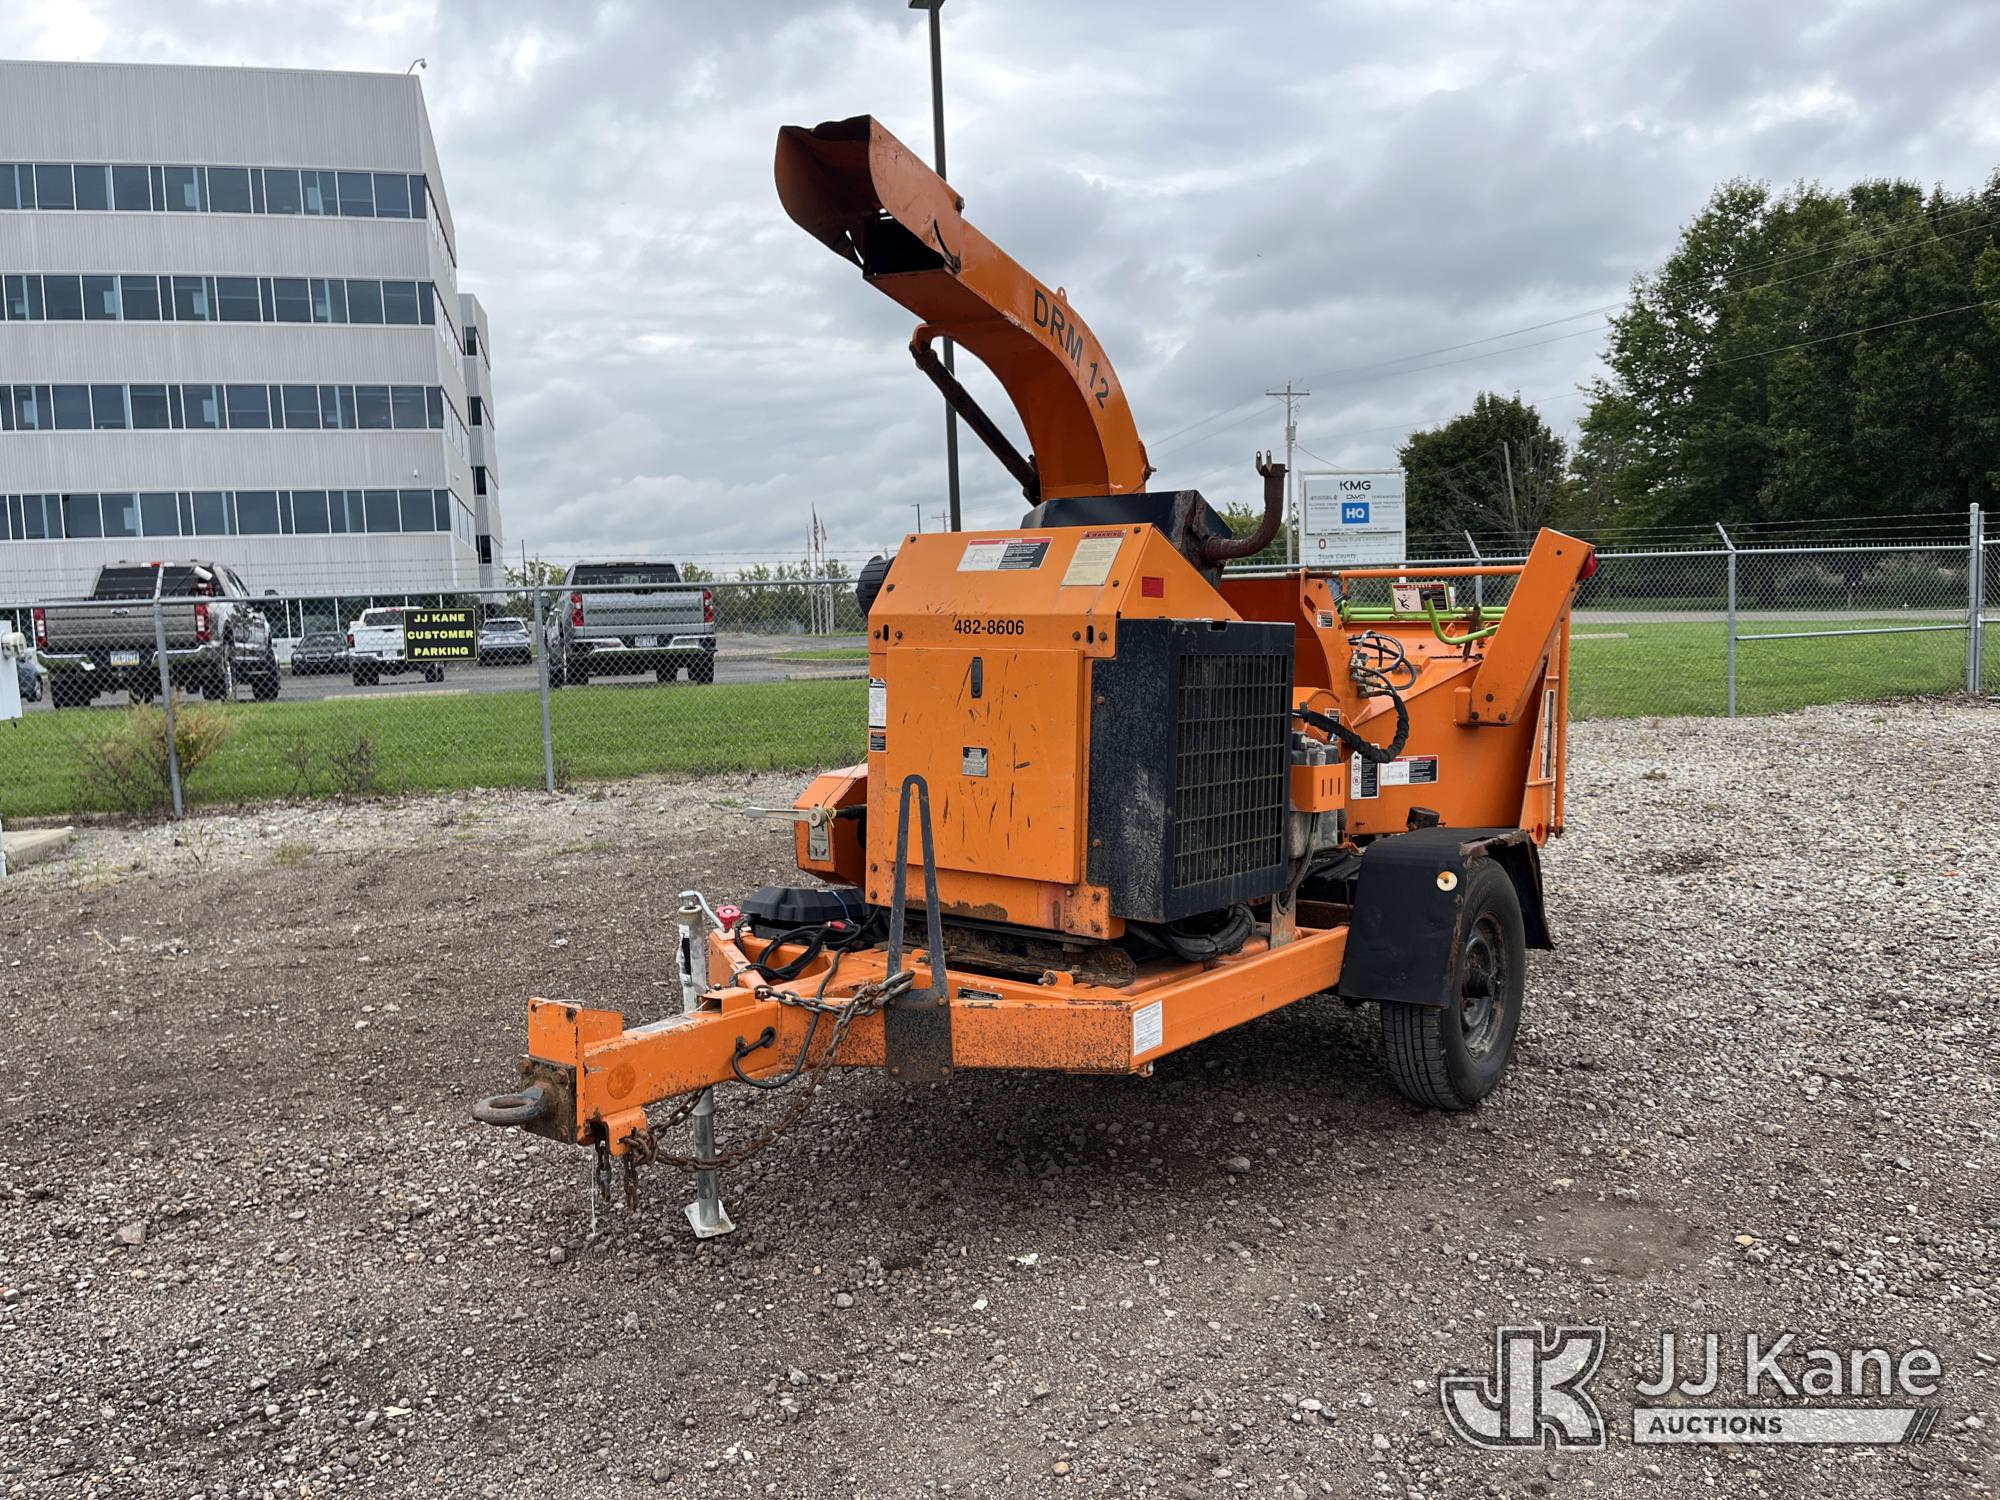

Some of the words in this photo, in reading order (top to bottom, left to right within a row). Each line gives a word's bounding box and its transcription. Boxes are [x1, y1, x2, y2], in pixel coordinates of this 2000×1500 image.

[1033, 287, 1084, 369] DRM
[1088, 361, 1110, 411] 12
[1339, 480, 1372, 491] KMG
[1346, 508, 1365, 519] HQ
[414, 614, 428, 622] JJ
[432, 614, 465, 622] KANE
[953, 619, 1025, 635] 482-8606
[407, 630, 474, 639] CUSTOMER
[414, 647, 469, 656] PARKING
